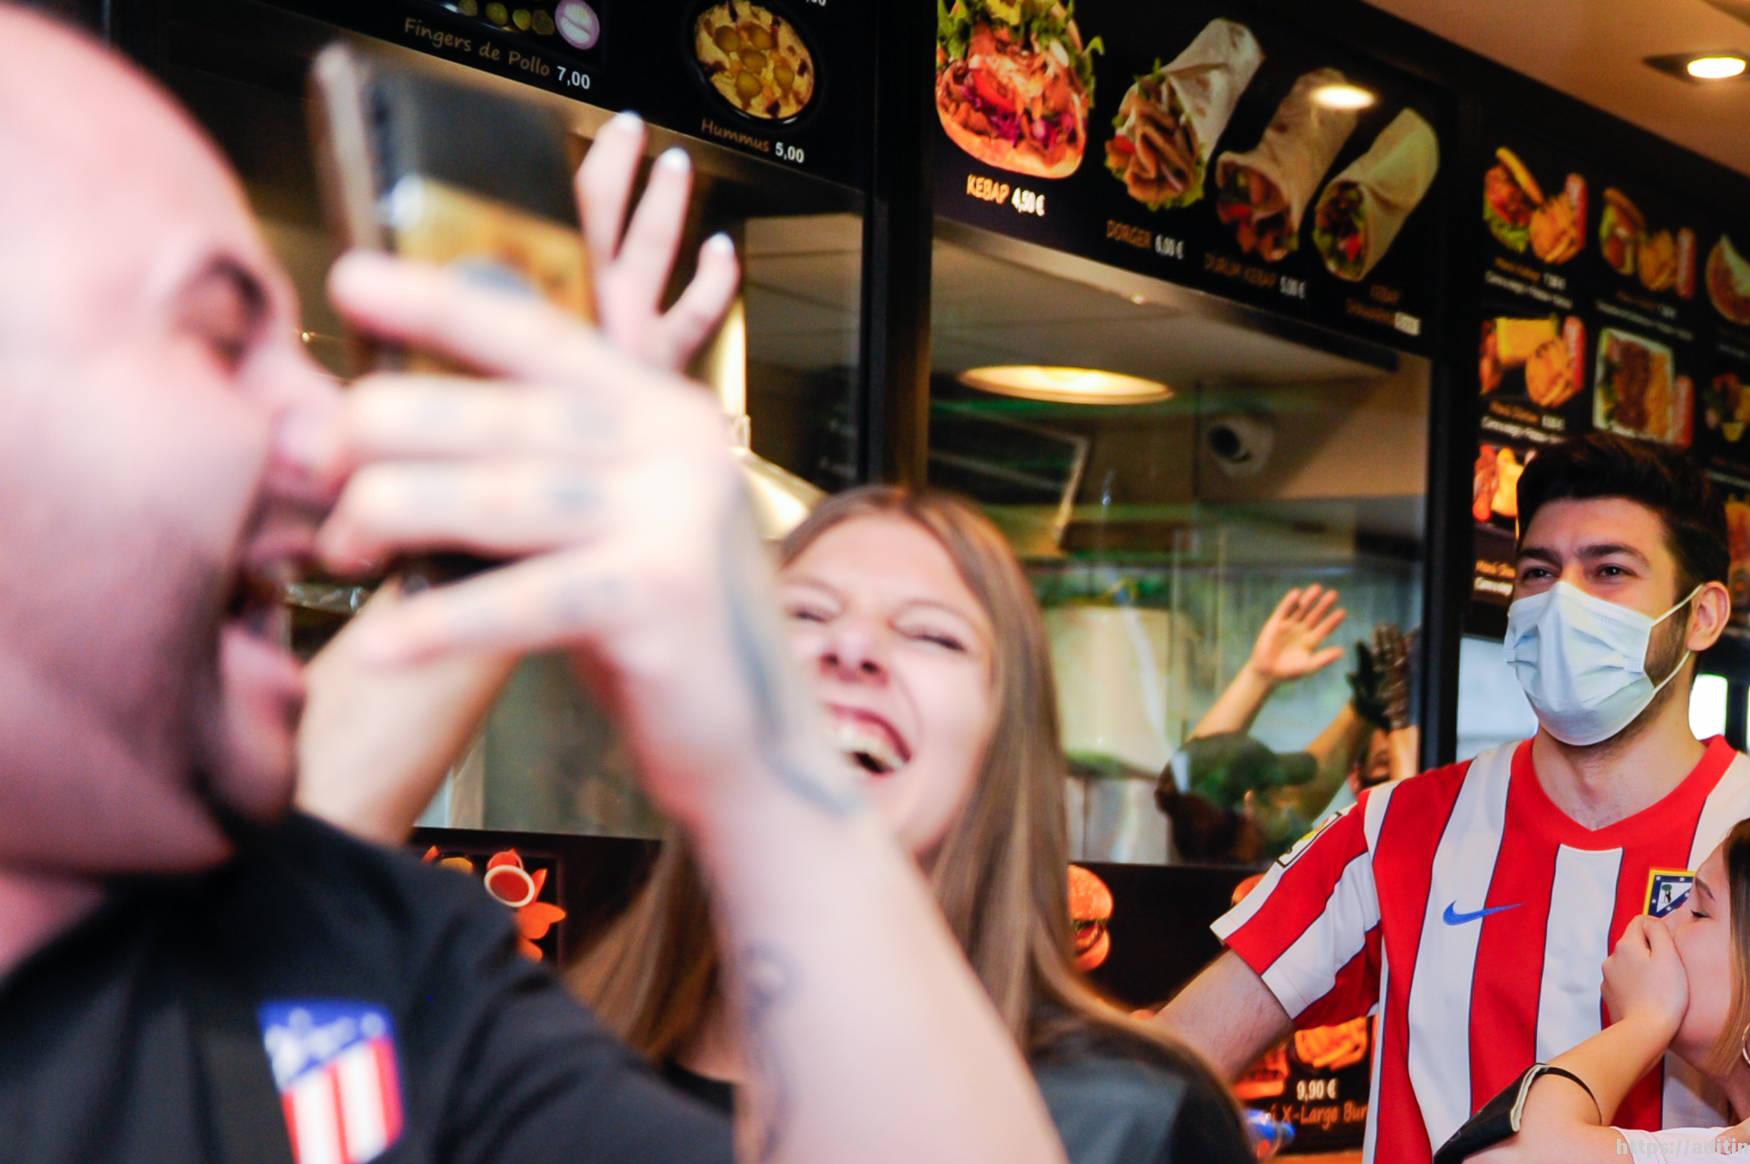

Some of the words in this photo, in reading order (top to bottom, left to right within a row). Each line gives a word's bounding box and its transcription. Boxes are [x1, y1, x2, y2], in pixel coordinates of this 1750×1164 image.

[404, 16, 472, 52] Fingers
[479, 41, 500, 61] de
[508, 50, 550, 77] Pollo
[556, 65, 591, 90] 7,00
[702, 118, 770, 152] Hummus
[775, 141, 805, 164] 5,00
[966, 174, 1010, 205] KEBAP
[1296, 1080, 1325, 1102] 9,90
[1282, 1103, 1339, 1130] X-Large
[1343, 1100, 1368, 1124] Bur
